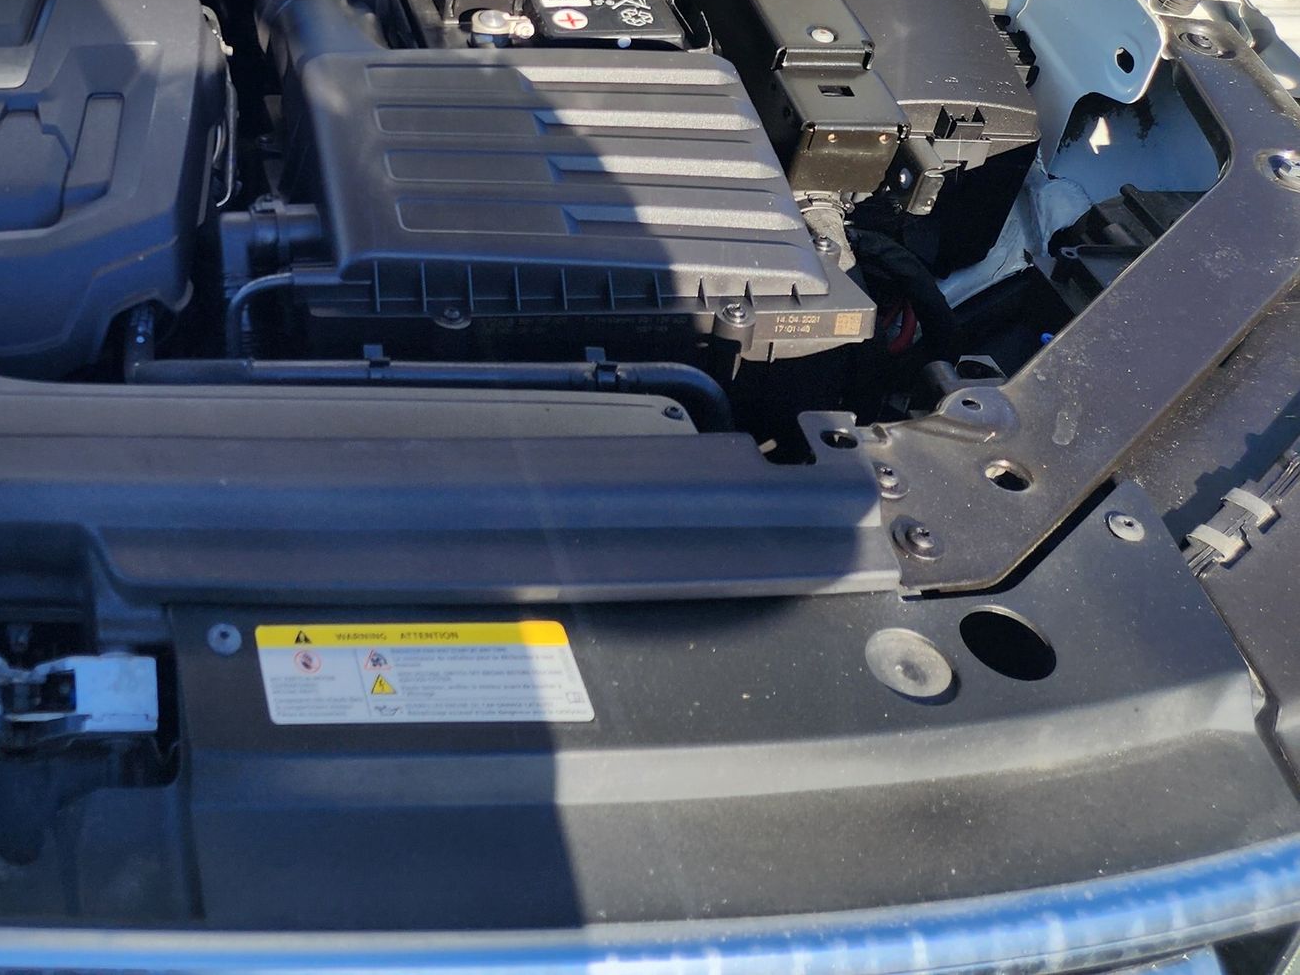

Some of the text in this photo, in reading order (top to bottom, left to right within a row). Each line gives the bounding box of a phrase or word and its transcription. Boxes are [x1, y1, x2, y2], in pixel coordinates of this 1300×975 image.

[776, 315, 821, 324] 14.04.2021
[335, 631, 459, 641] WARNING ATTENTION
